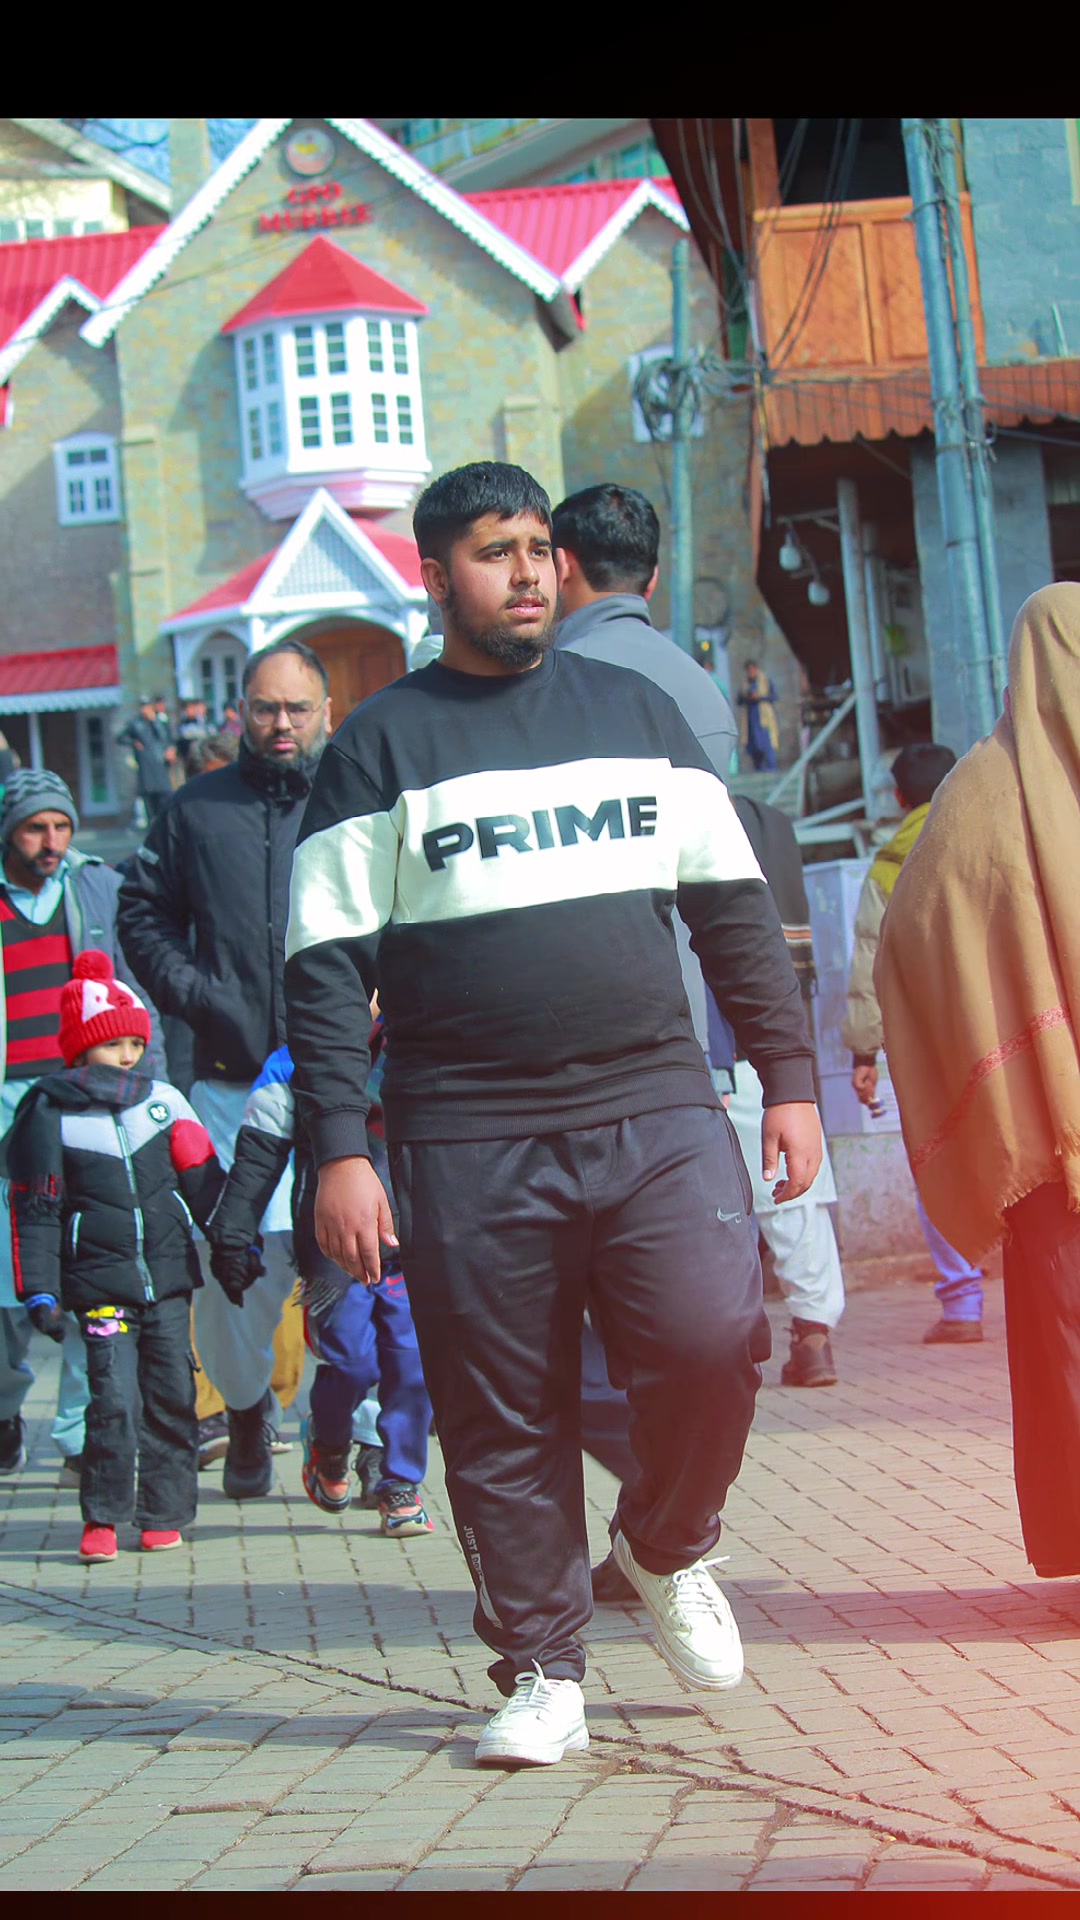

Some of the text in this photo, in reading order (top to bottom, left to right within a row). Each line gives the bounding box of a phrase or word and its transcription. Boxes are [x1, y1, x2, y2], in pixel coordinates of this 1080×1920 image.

[287, 181, 343, 203] GPO
[258, 203, 373, 232] MURREE
[422, 796, 658, 872] PRIME
[463, 1526, 478, 1551] JUST
